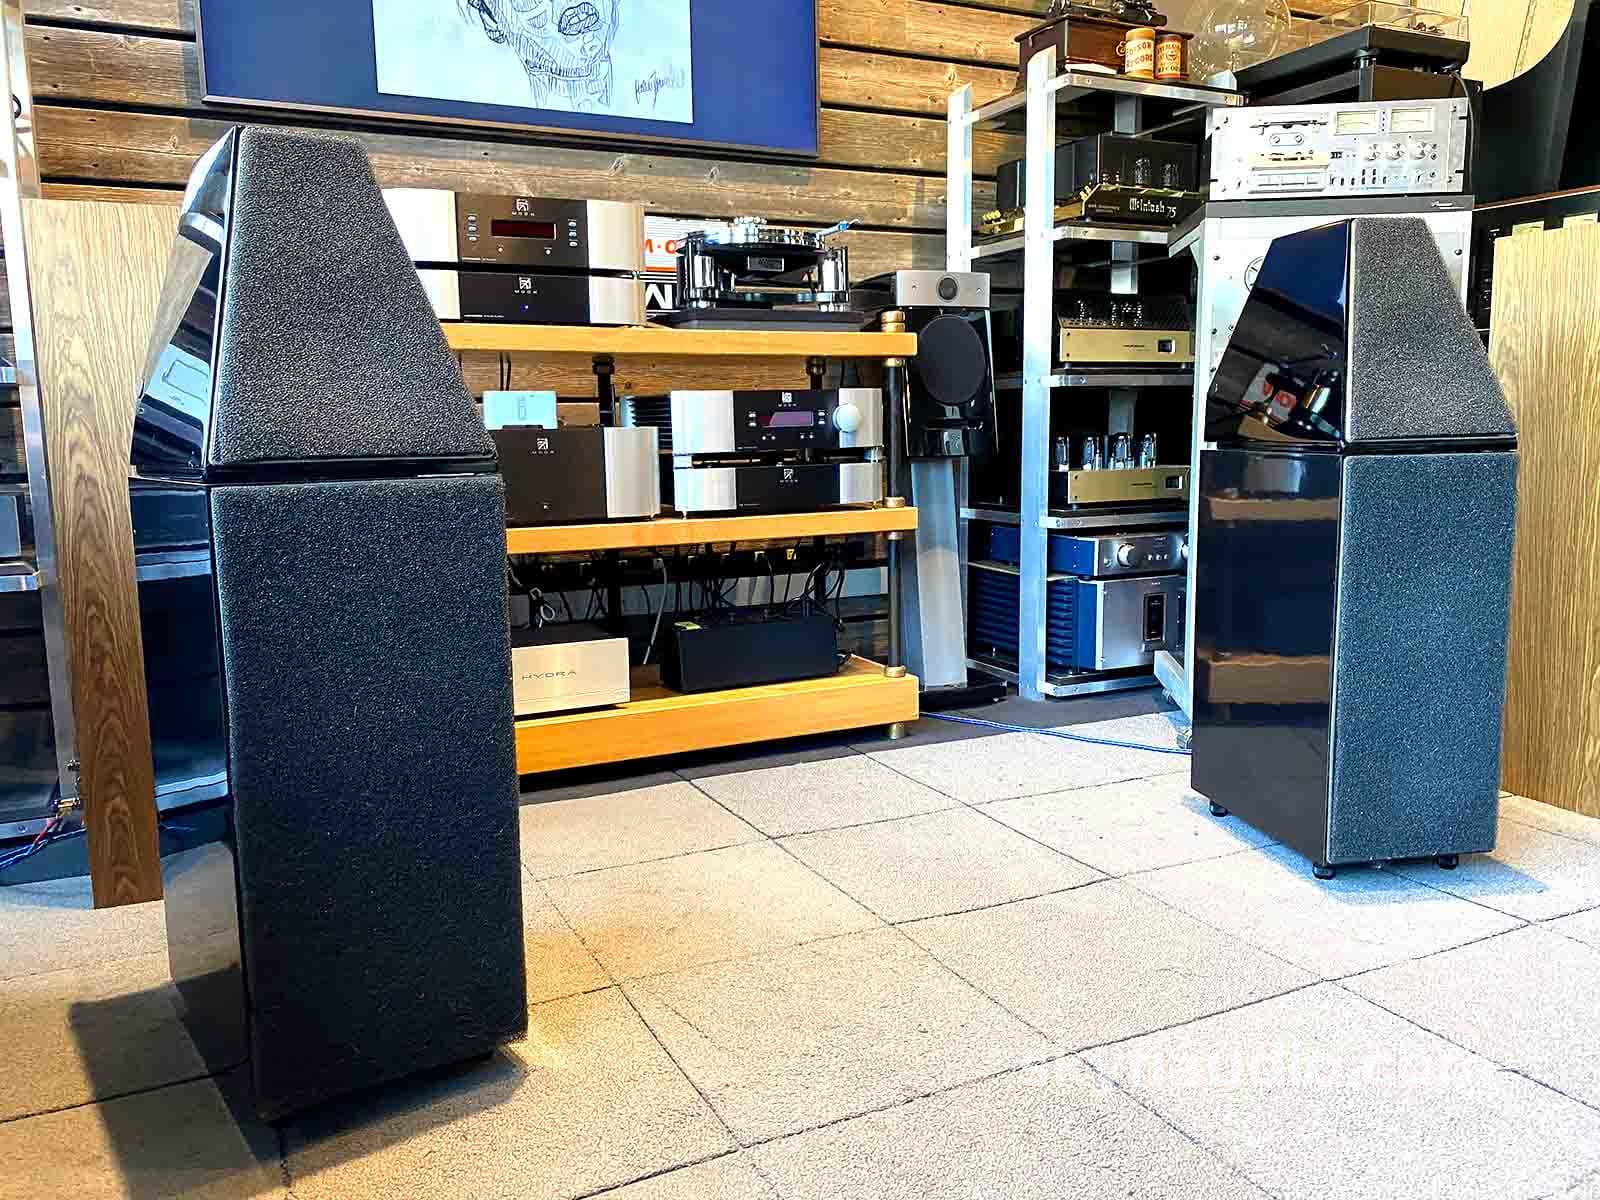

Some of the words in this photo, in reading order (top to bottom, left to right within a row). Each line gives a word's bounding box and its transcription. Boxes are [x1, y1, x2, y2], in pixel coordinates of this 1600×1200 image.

[1128, 197, 1166, 214] McIntosh
[1167, 206, 1177, 218] 75
[521, 669, 577, 681] HYDRA
